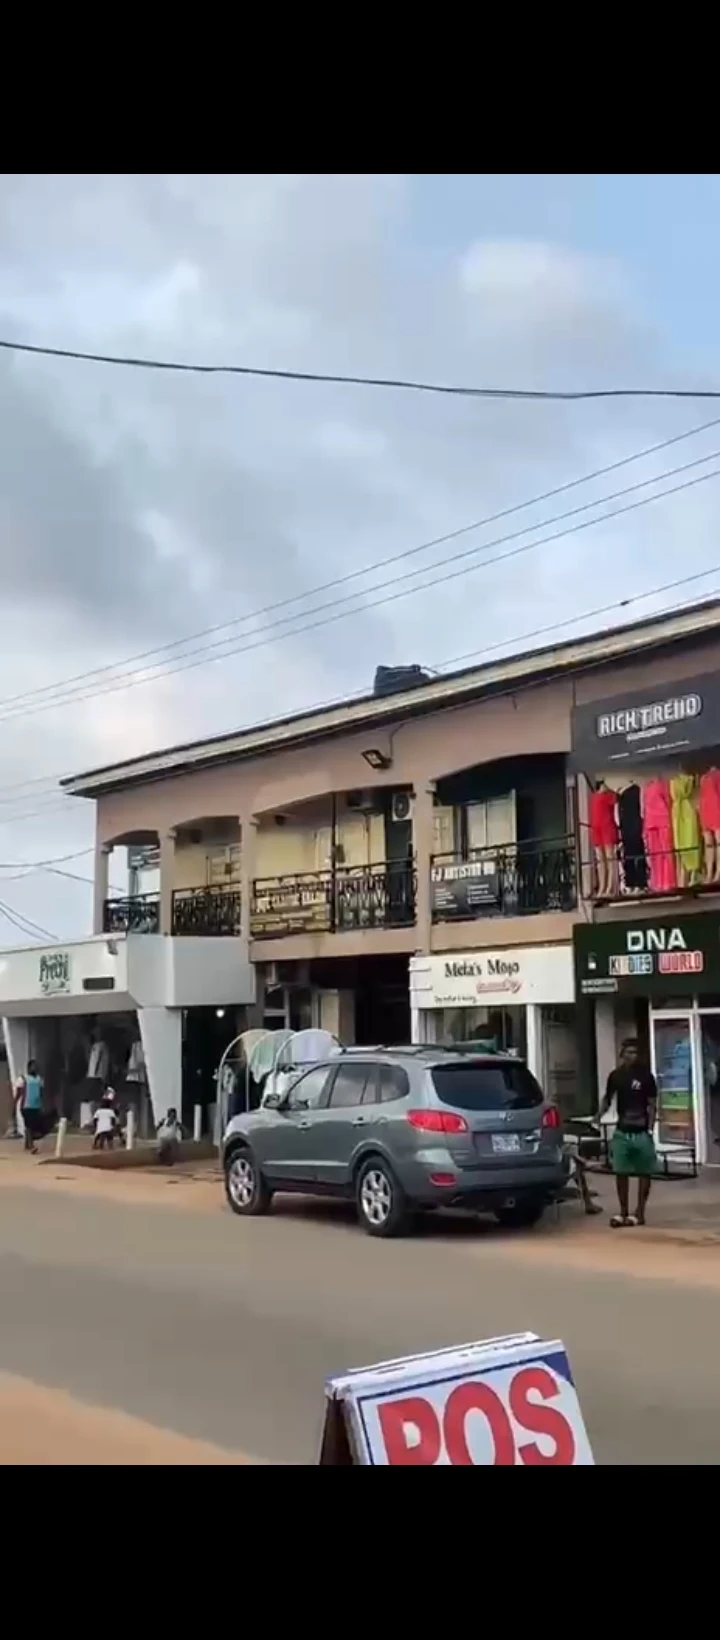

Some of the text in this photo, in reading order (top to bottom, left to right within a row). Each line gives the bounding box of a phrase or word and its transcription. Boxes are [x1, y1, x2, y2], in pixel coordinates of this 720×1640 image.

[598, 708, 638, 737] RICH
[627, 928, 687, 951] DNA
[487, 959, 520, 976] Mojo
[658, 951, 703, 974] WORLD
[377, 1366, 575, 1465] POS
